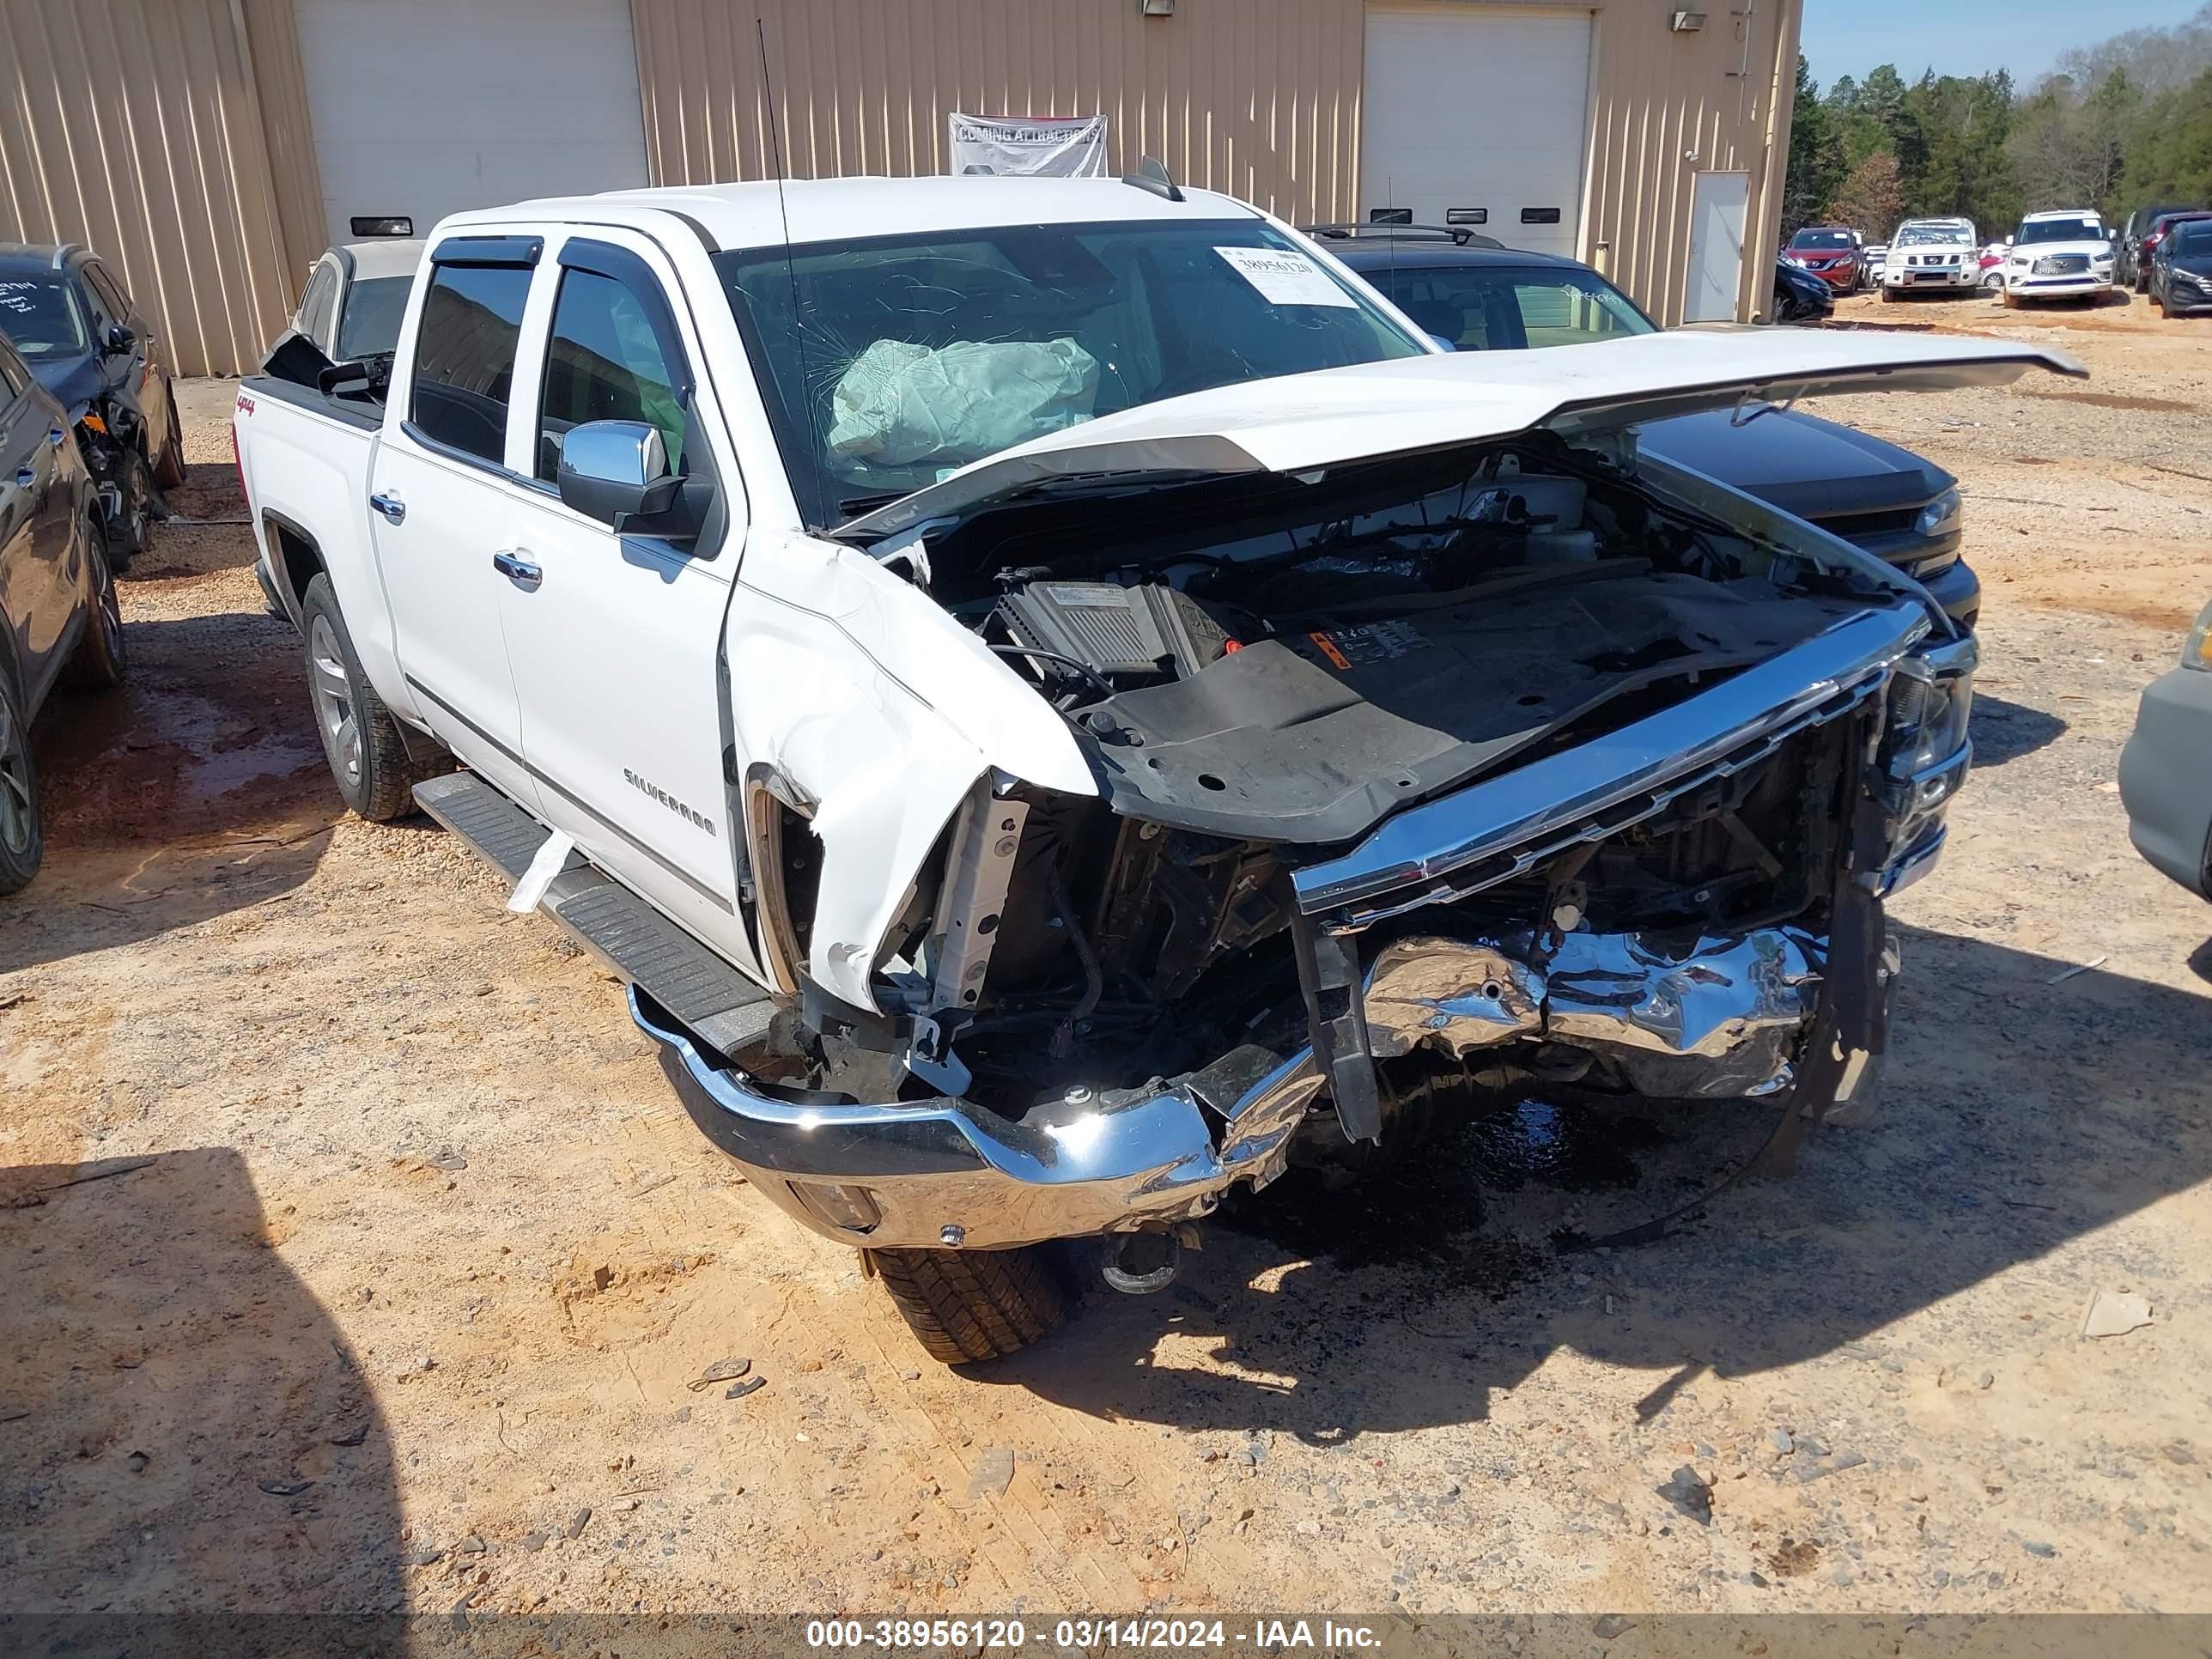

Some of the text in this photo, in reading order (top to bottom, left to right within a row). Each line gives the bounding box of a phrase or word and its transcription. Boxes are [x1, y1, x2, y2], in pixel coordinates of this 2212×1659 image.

[958, 125, 1011, 141] COMING
[1238, 258, 1313, 274] 38956120
[623, 768, 717, 837] SILVERADO
